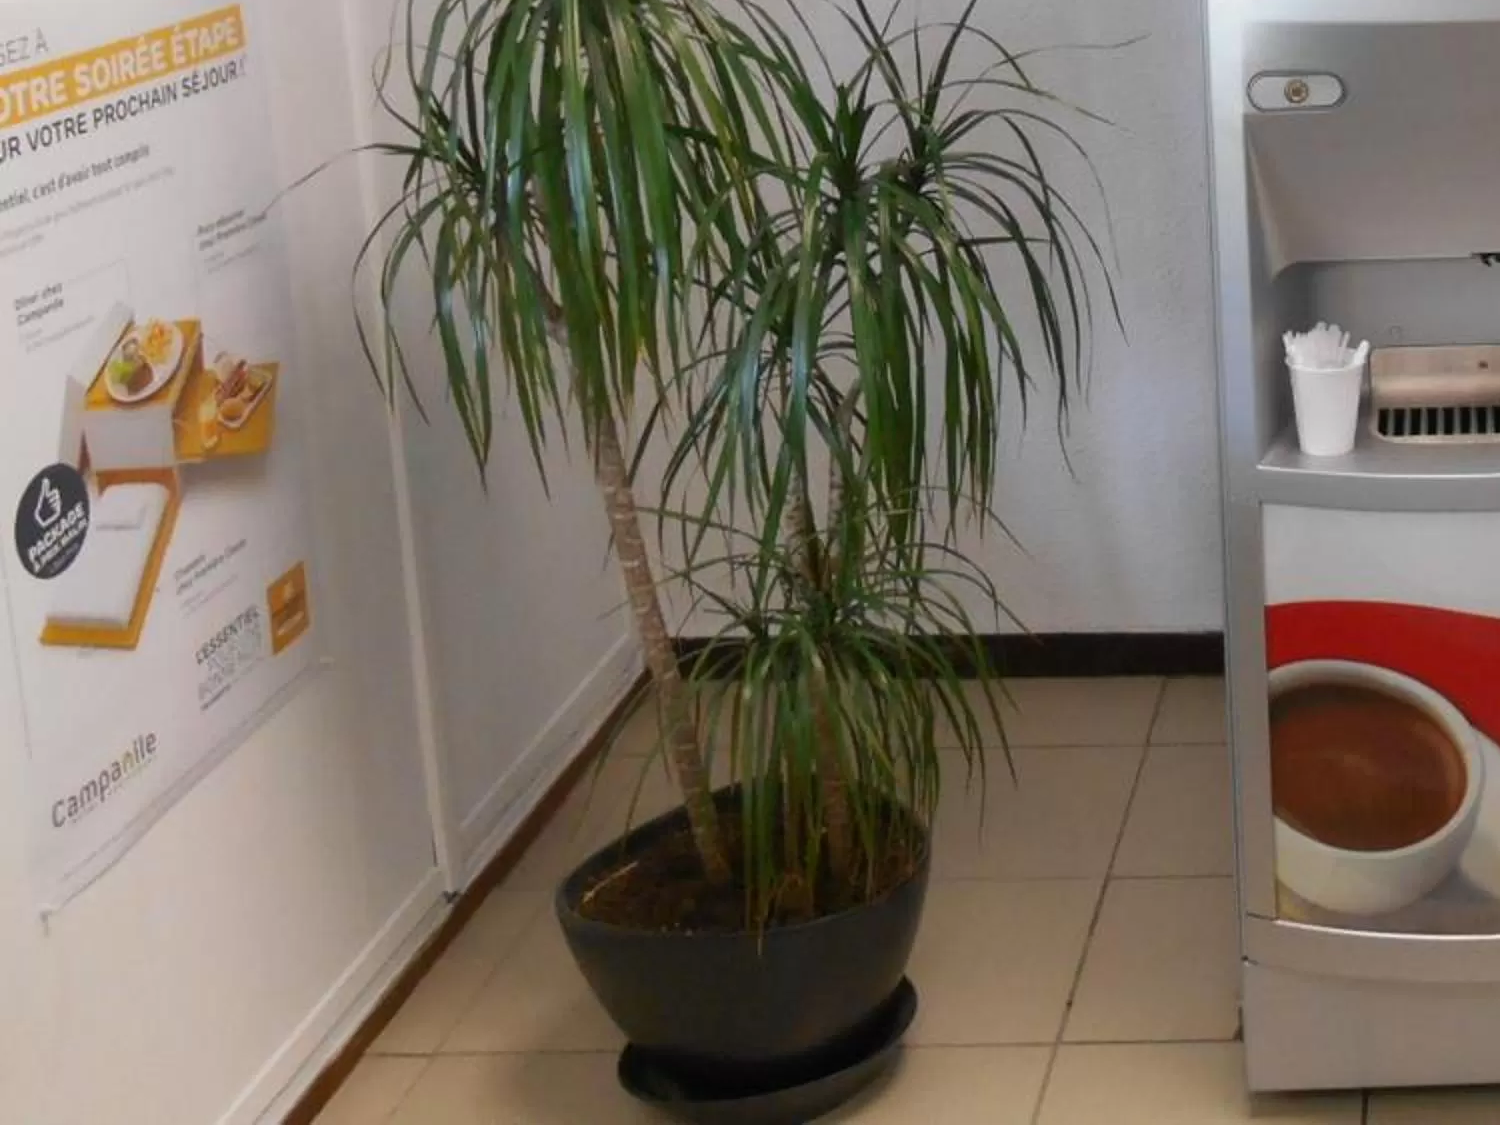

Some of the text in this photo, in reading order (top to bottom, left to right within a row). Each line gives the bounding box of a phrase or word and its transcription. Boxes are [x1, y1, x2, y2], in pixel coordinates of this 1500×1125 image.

[74, 35, 168, 96] SOIRÉE
[171, 16, 240, 65] ÉTAPE
[26, 113, 88, 151] VOTRE
[92, 82, 178, 129] PROCHAIN
[181, 60, 237, 98] SÉJOUR
[28, 501, 84, 562] PACKAGE
[50, 729, 158, 830] Campanile
